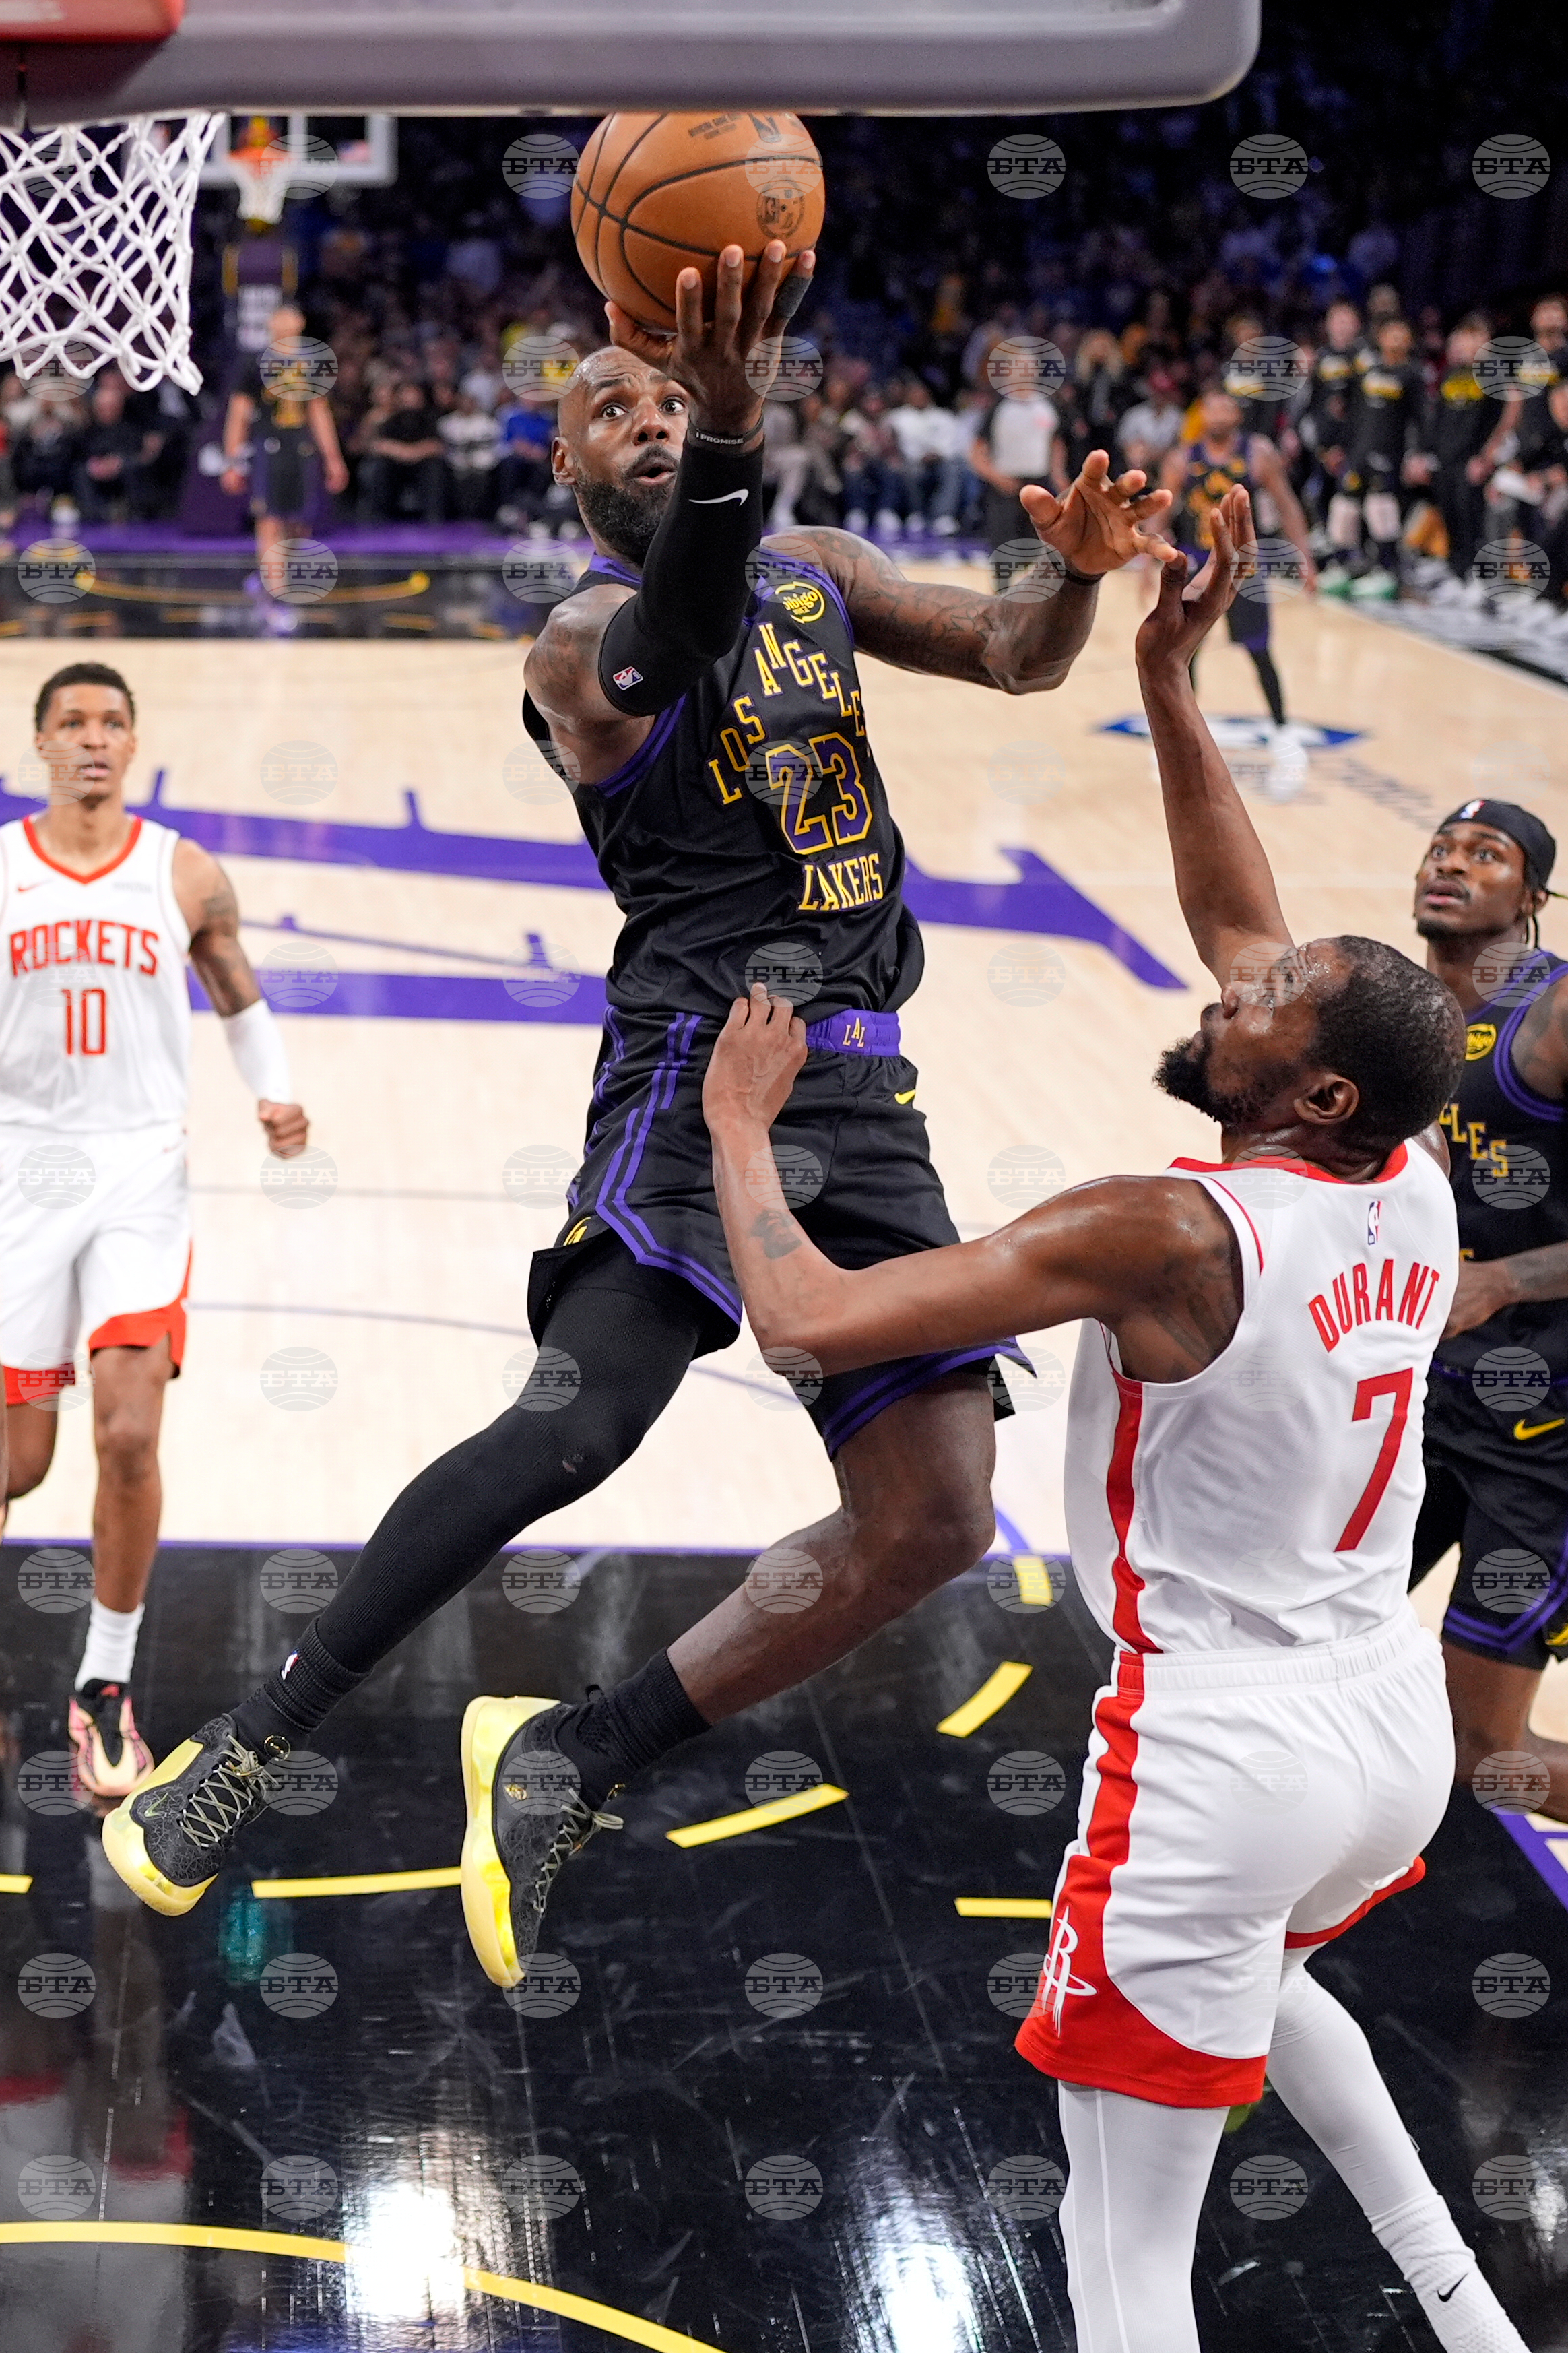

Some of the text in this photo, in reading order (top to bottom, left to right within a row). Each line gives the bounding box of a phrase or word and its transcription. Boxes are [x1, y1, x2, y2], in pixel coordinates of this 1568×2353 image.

[700, 433, 744, 445] PROMISE
[708, 622, 869, 806] LOS ANGELE
[765, 732, 873, 855] 23
[797, 851, 884, 912] LAKERS
[9, 918, 160, 977] ROCKETS
[61, 988, 106, 1056] 10
[843, 1017, 865, 1048] LAL
[1309, 1258, 1440, 1353] DURANT
[1334, 1367, 1413, 1553] 7
